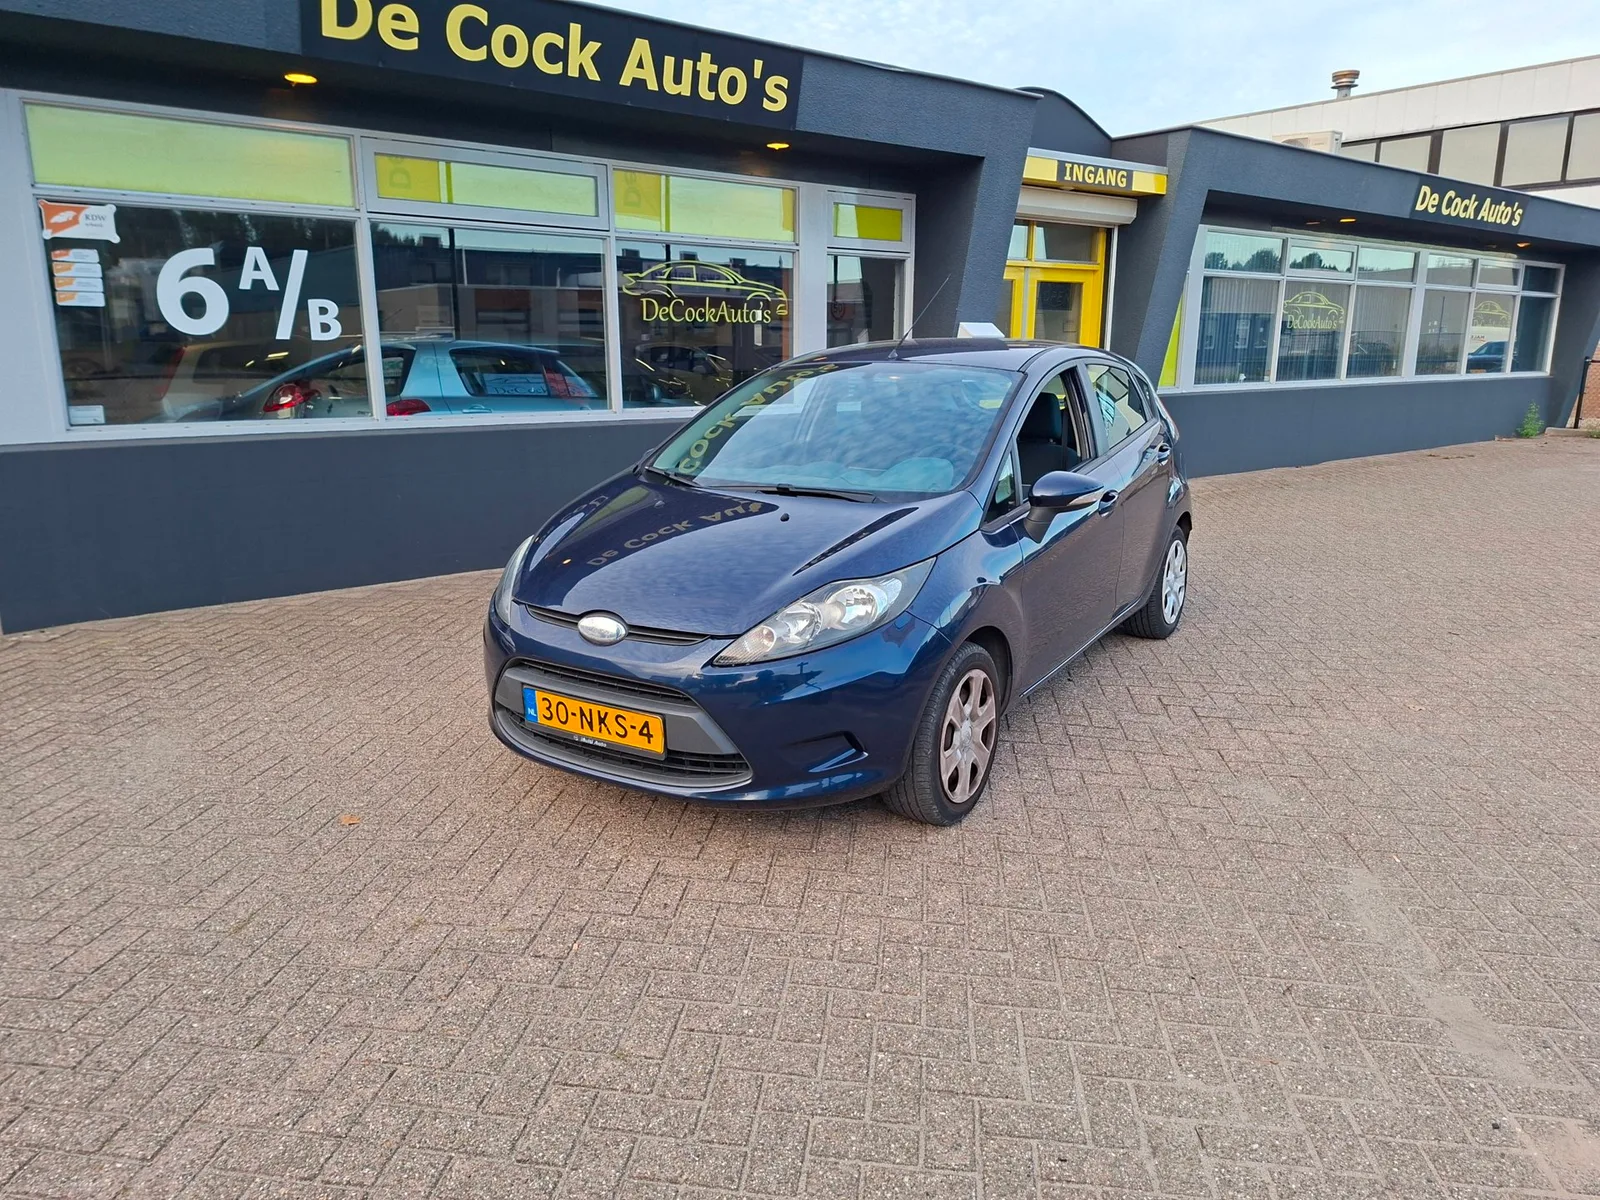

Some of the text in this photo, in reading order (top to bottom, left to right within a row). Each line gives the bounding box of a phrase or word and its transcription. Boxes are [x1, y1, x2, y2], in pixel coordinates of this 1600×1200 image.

[320, 0, 789, 112] De Cock Auto's
[1064, 163, 1127, 188] INGANG
[1415, 185, 1523, 227] De Cock Auto's
[640, 296, 772, 324] DeCockAuto's
[1287, 313, 1338, 330] DeCockAuto's
[527, 706, 537, 718] NL
[541, 697, 654, 745] 30-NKS-4
